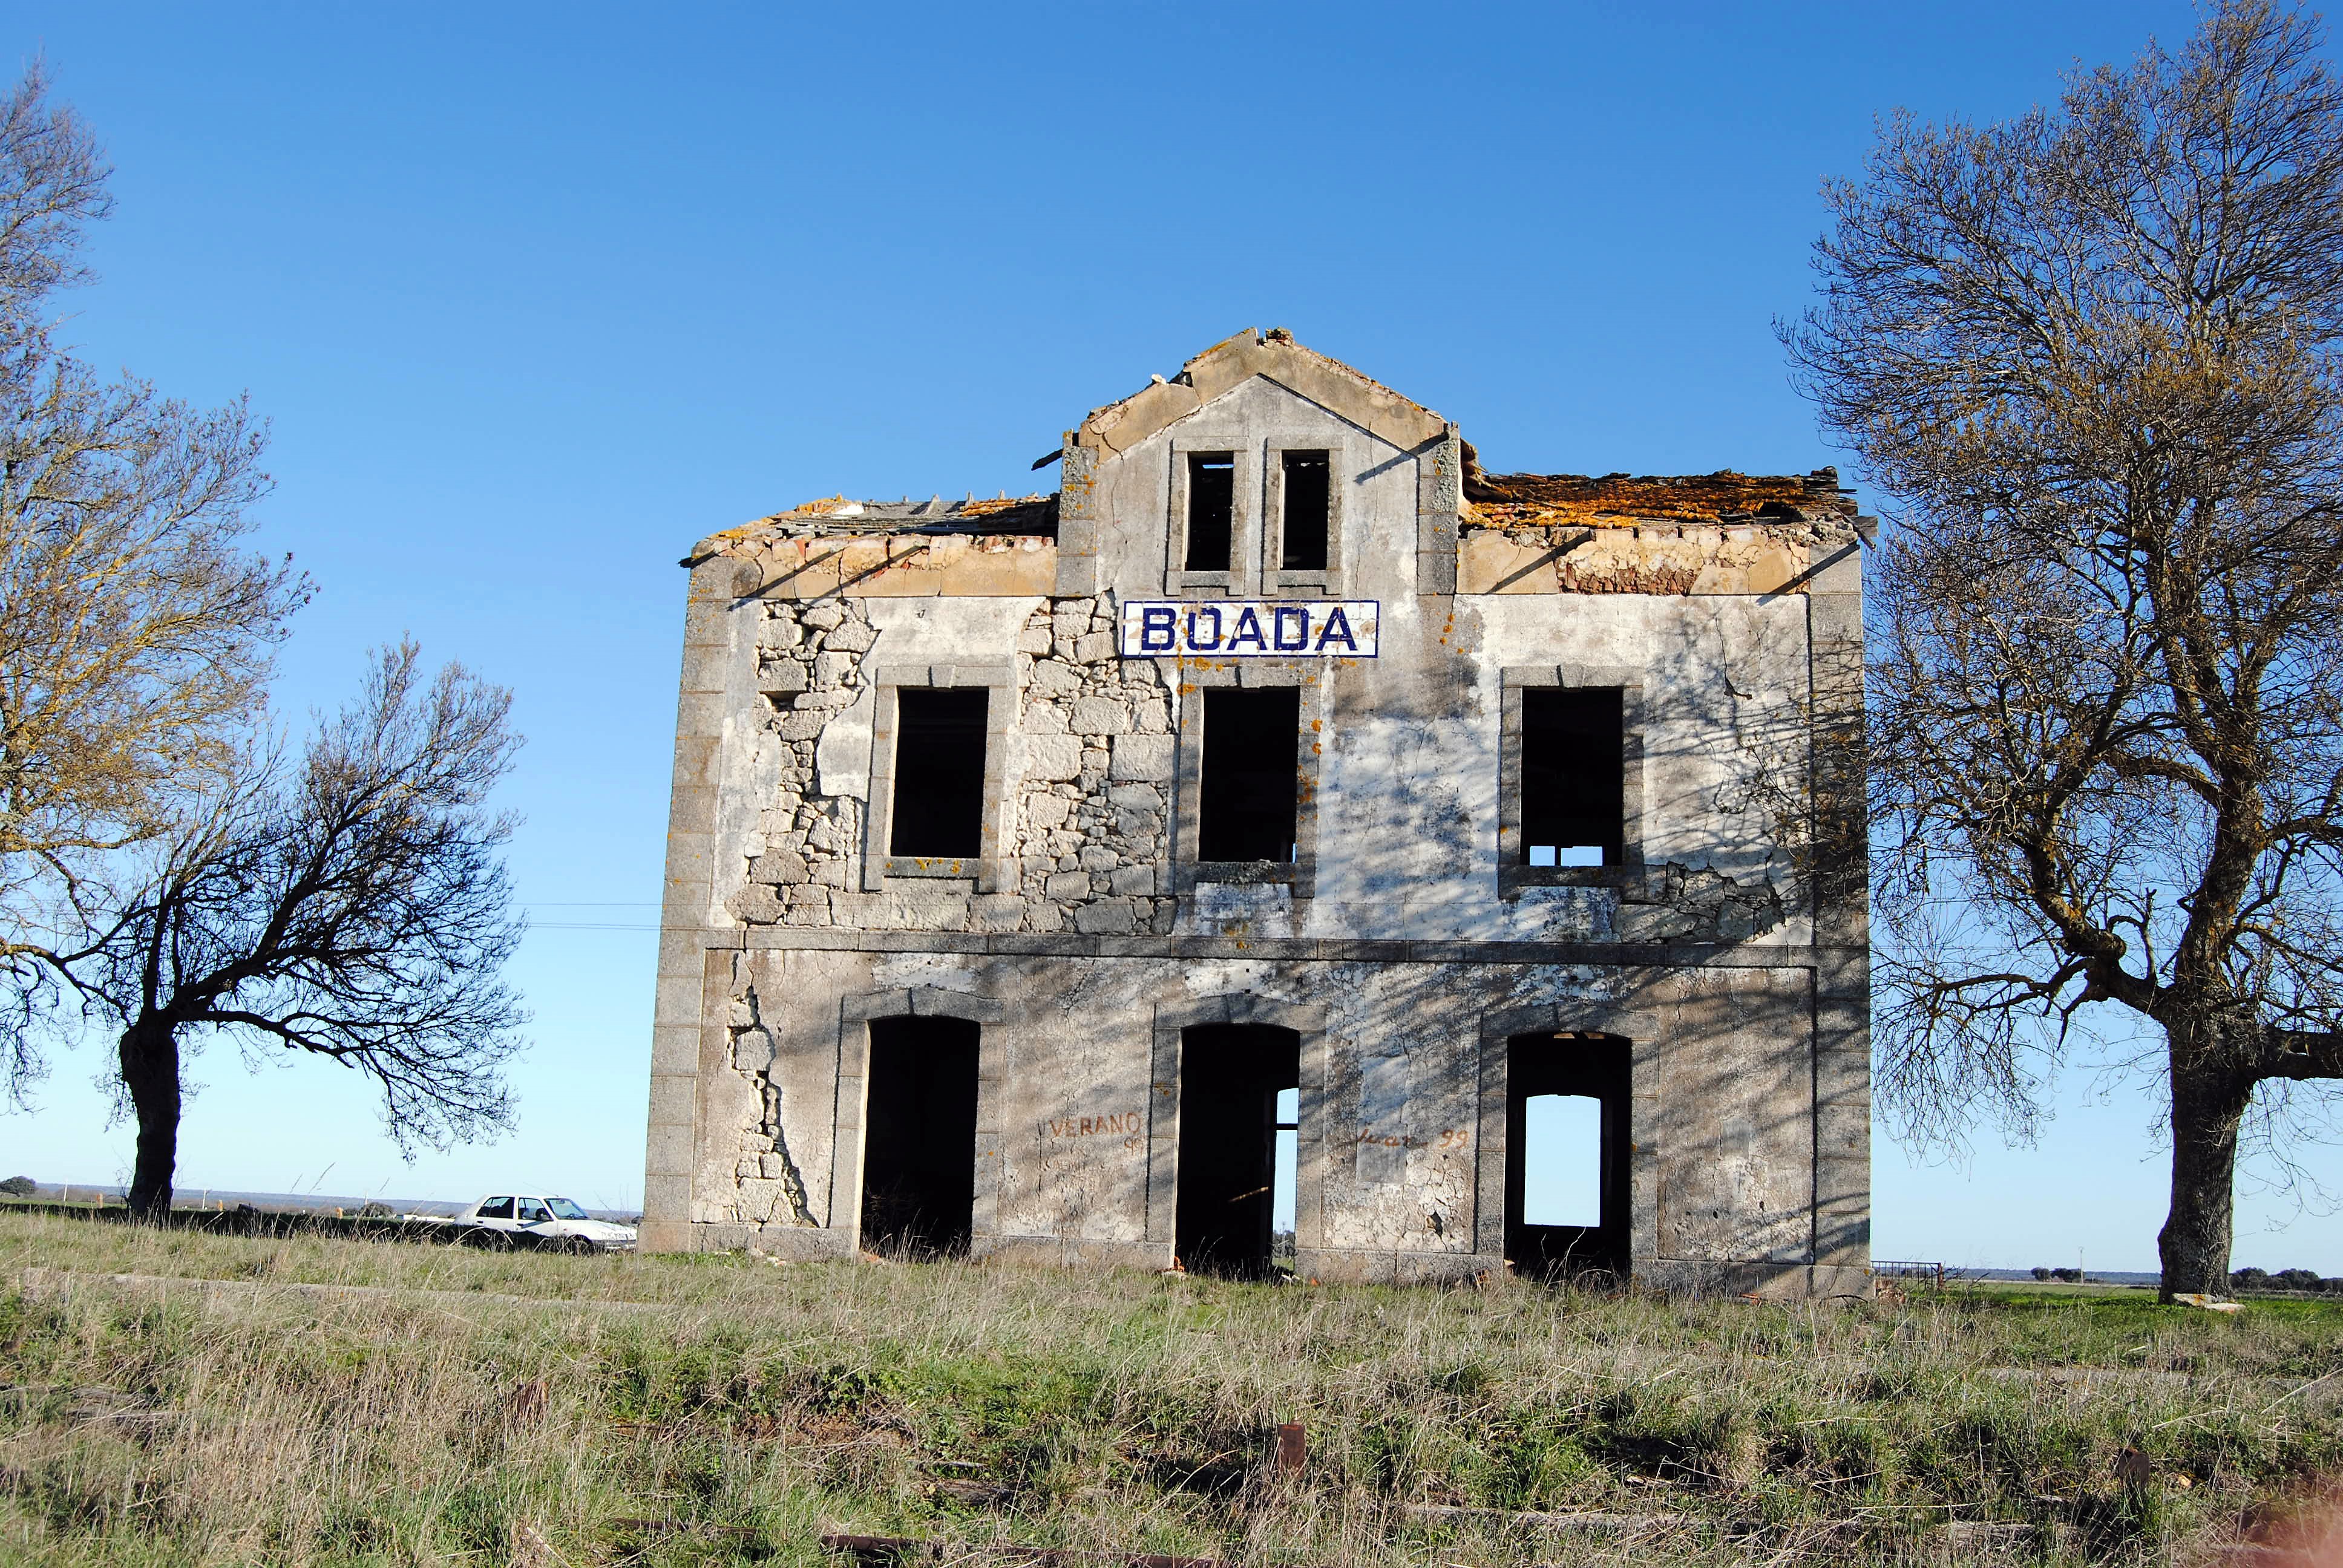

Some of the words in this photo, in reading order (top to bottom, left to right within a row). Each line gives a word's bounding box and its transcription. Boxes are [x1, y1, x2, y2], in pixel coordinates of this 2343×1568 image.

[1141, 607, 1358, 652] BOADA
[1049, 1112, 1141, 1137] VERANO
[1124, 1136, 1144, 1157] 99
[1440, 1129, 1469, 1148] 99
